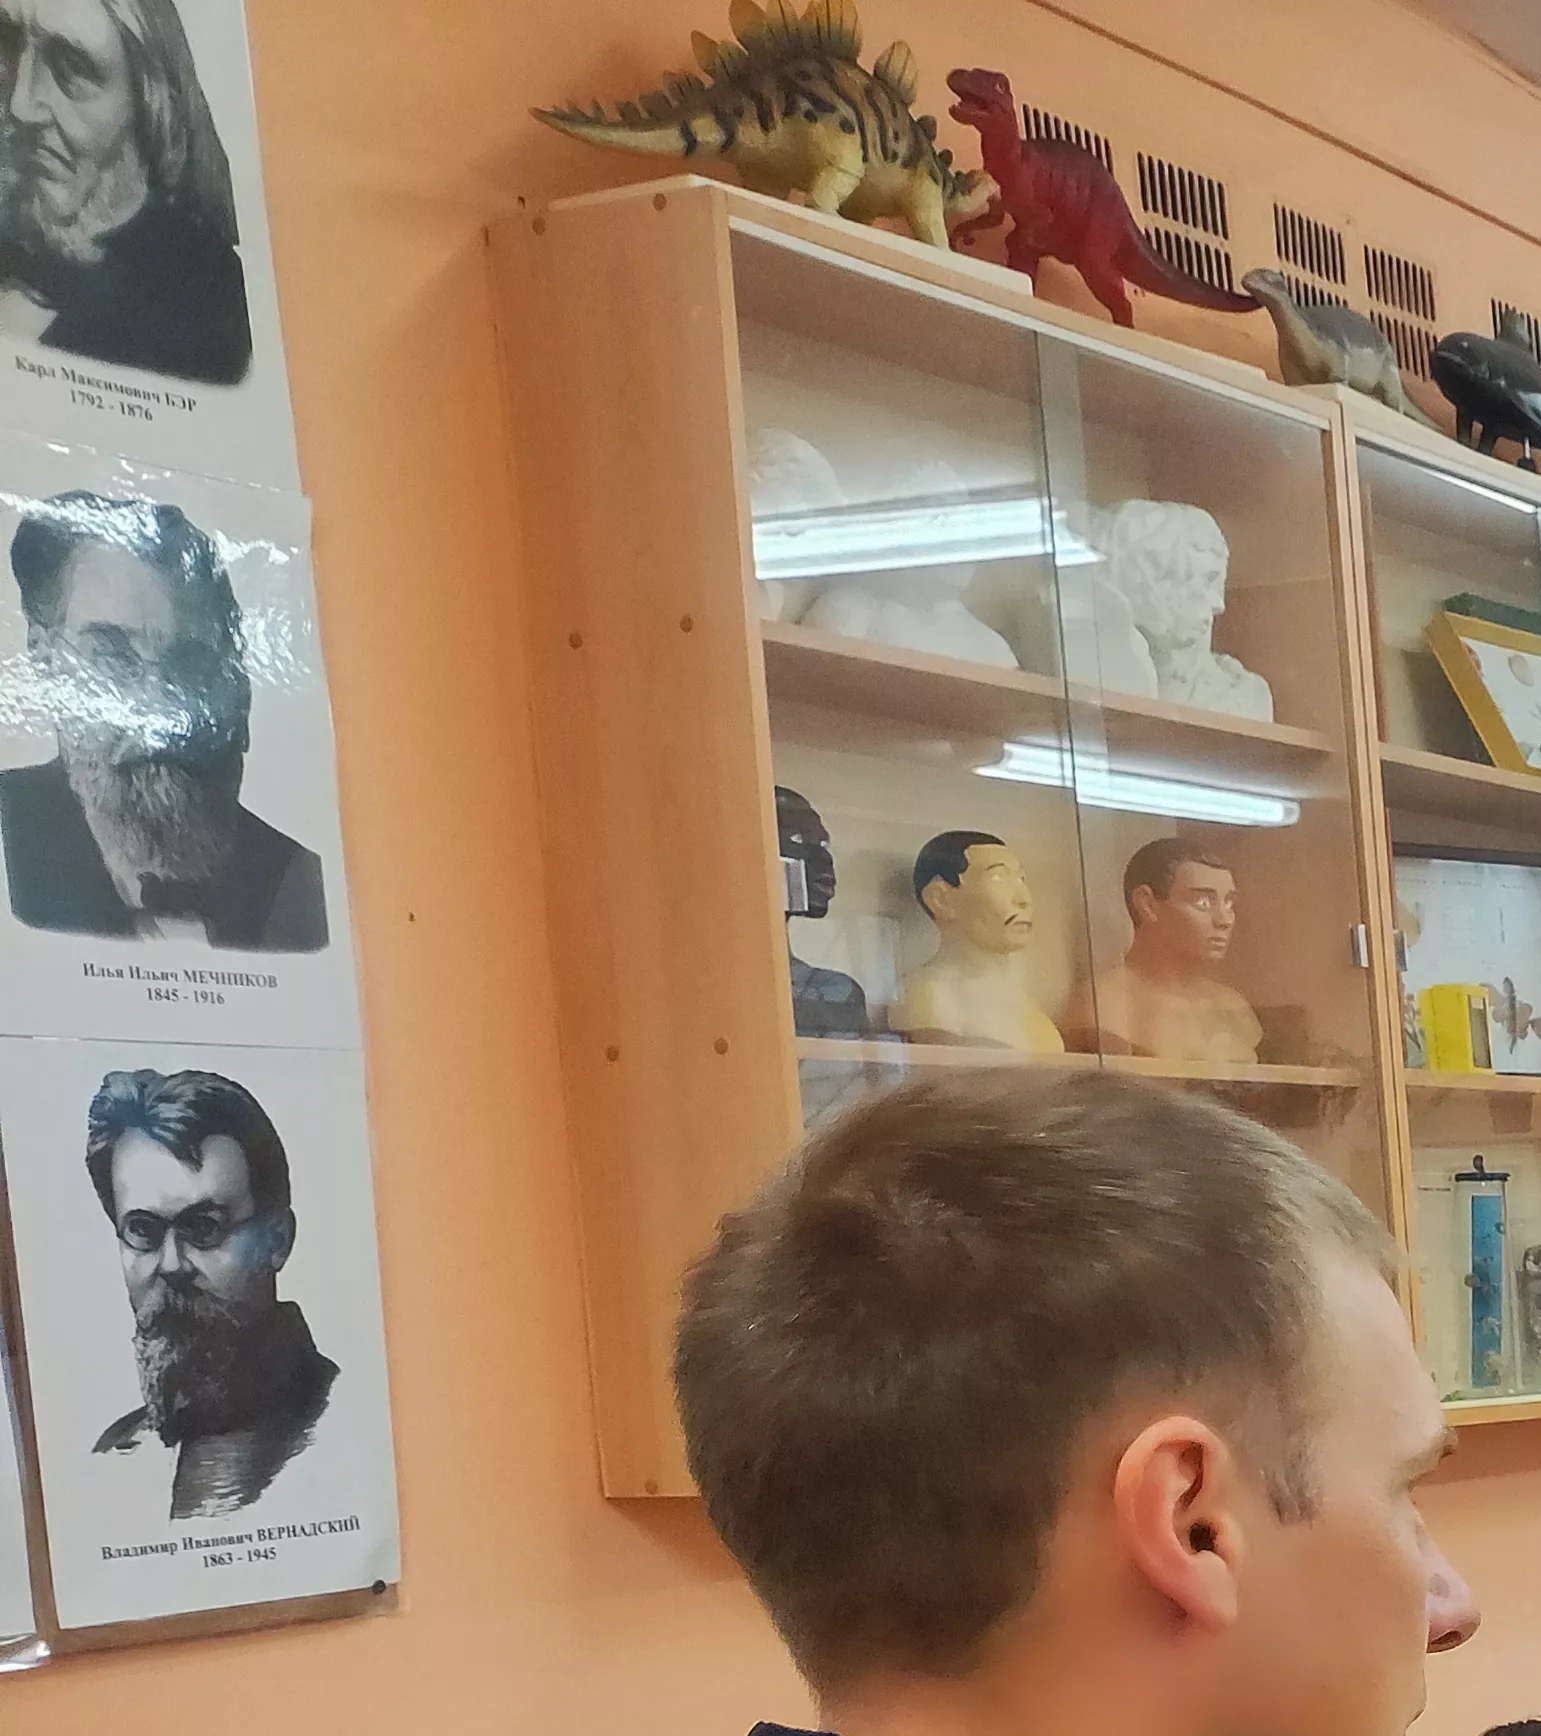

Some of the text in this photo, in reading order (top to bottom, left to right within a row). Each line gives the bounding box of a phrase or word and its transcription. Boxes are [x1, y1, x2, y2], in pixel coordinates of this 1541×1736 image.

[15, 355, 197, 412] Карл Максимович БЭР
[70, 389, 105, 411] 1792
[119, 400, 154, 422] 1876
[82, 962, 279, 989] Илья Ильич МЕЧНИКОВ
[146, 987, 180, 1003] 1845
[193, 990, 226, 1006] 1916
[101, 1515, 361, 1561] Владимир Иванович ВЕРНАДСКИЙ
[202, 1552, 234, 1569] 1863
[246, 1547, 278, 1563] 1945
